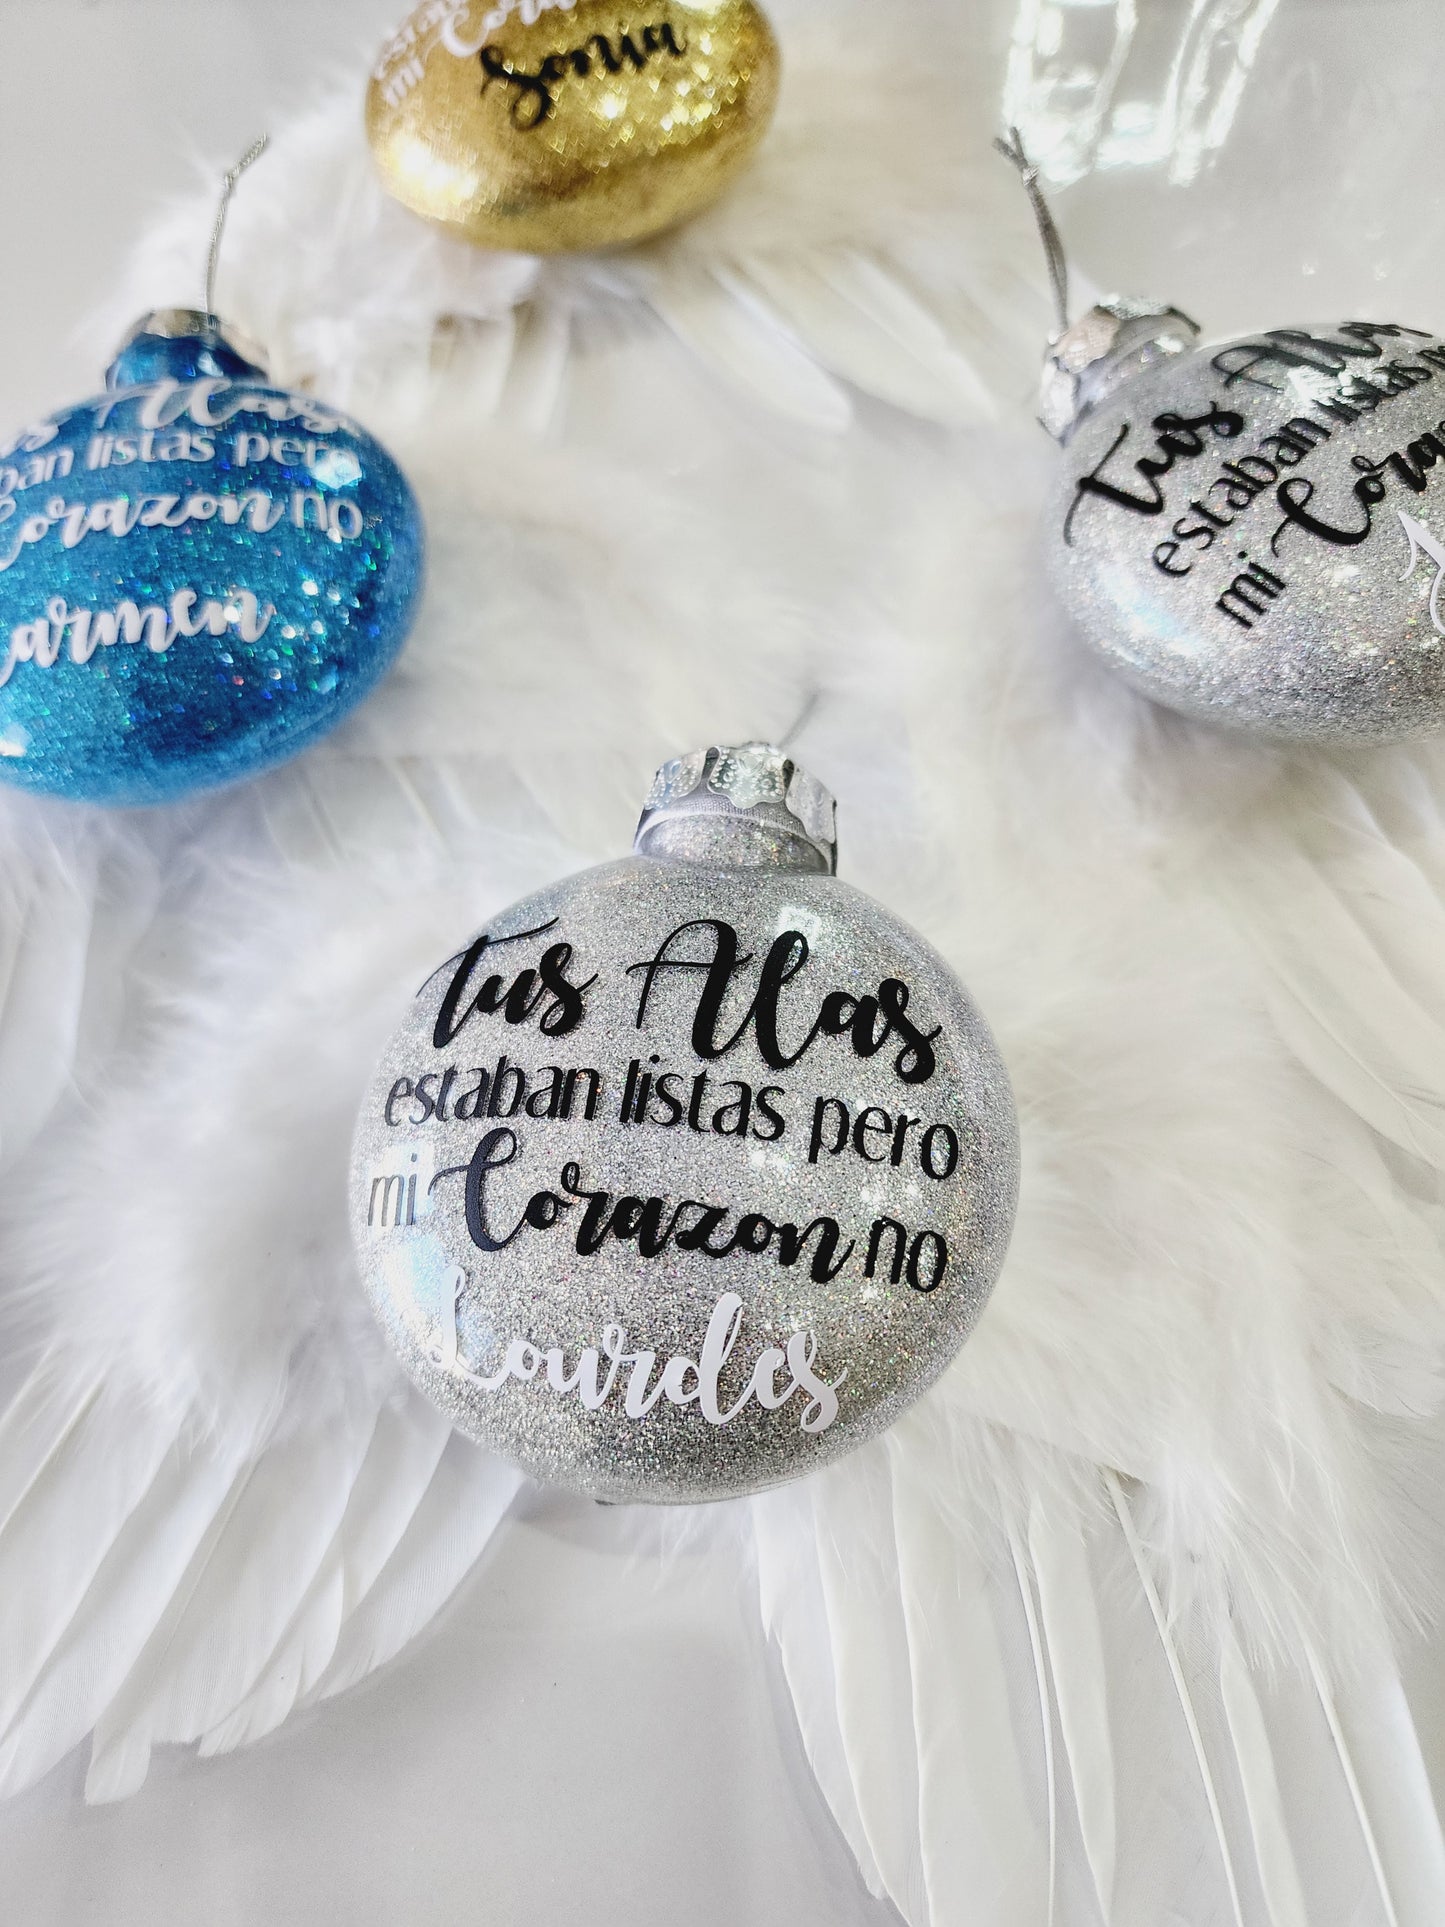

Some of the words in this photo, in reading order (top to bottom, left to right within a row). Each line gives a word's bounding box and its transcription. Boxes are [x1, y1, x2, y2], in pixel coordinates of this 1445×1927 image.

[88, 429, 215, 470] listas
[234, 432, 362, 486] per
[292, 489, 363, 540] no
[1064, 401, 1243, 547] Tus
[1152, 418, 1332, 578] estaban
[1215, 551, 1286, 628] mi
[415, 917, 598, 1049] Tus
[626, 919, 942, 1084] Alas
[385, 1055, 600, 1127] estaban
[618, 1053, 786, 1142] listas
[808, 1095, 959, 1181] pero
[367, 1152, 418, 1227] mi
[428, 1126, 855, 1284] Corazon
[864, 1216, 948, 1293] no
[425, 1264, 847, 1433] Lourdes
